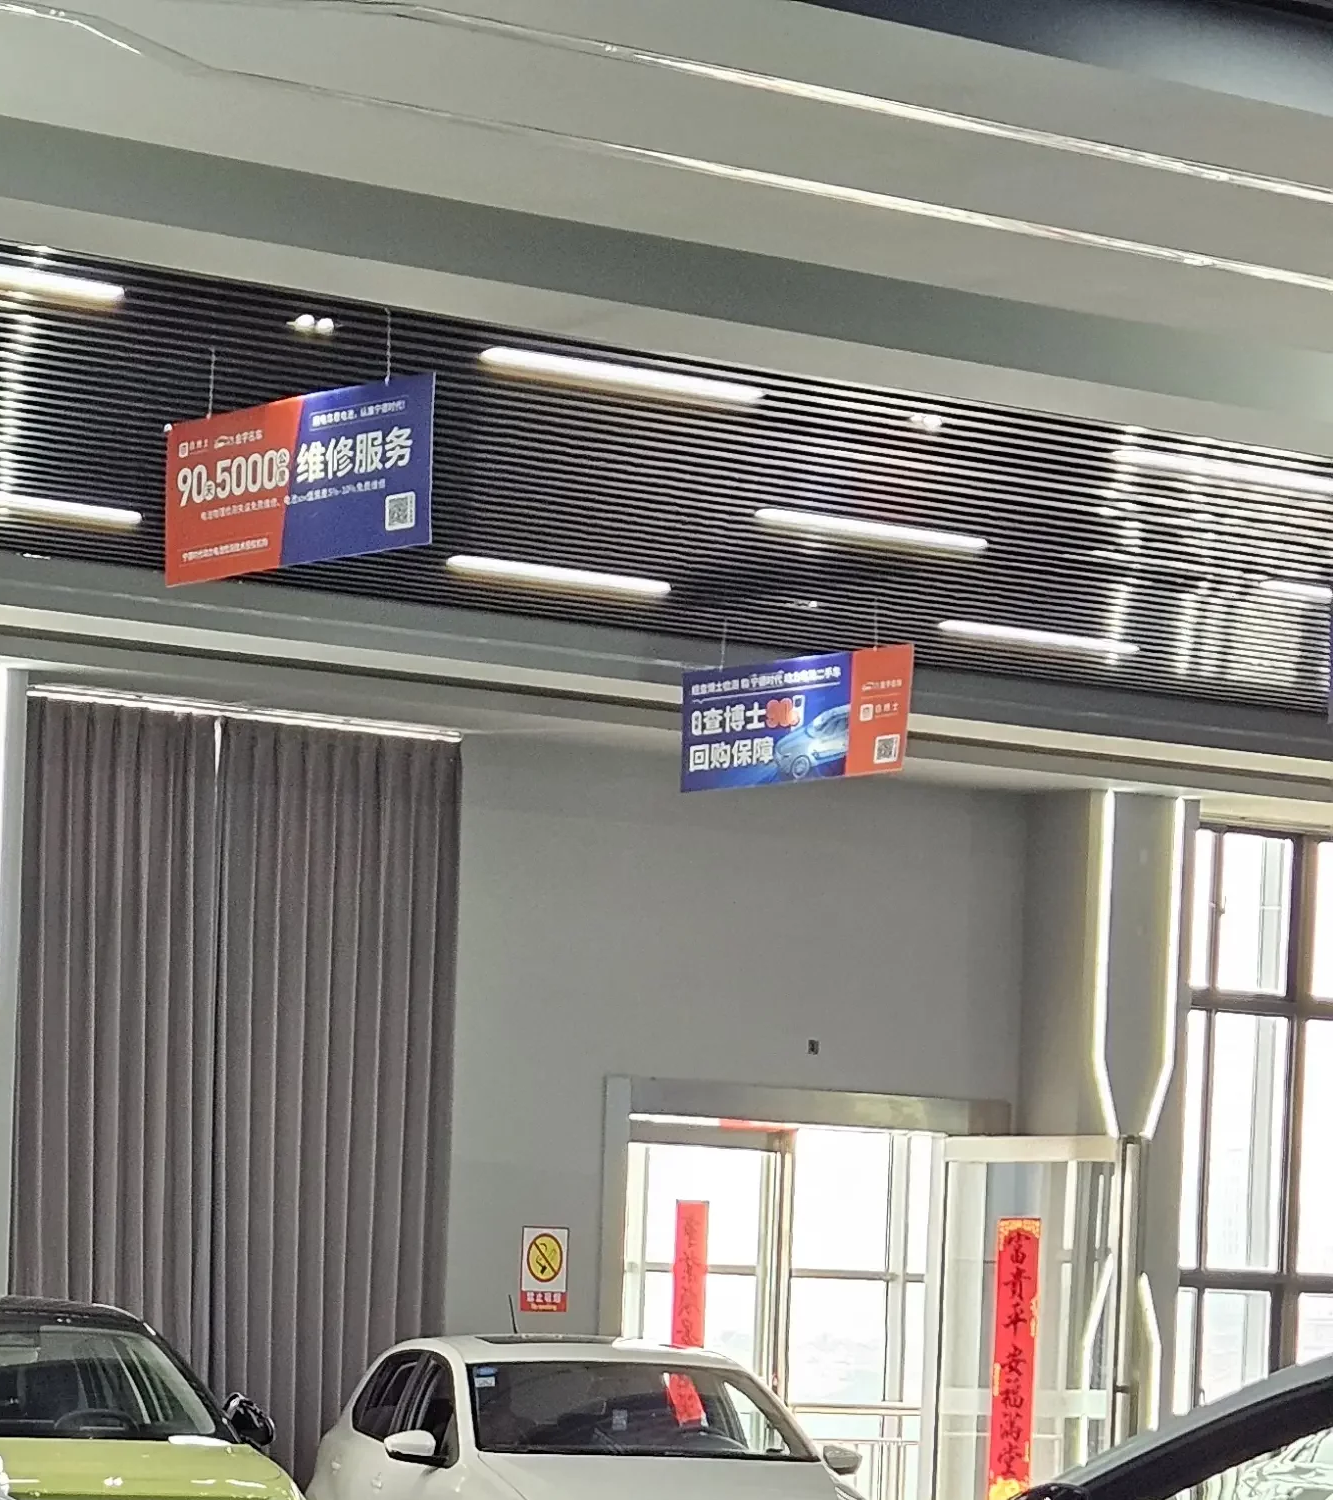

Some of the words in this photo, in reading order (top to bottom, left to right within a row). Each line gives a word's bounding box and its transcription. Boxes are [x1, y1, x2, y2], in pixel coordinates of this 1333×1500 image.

[296, 426, 413, 484] 维修服务
[703, 702, 766, 735] 查博士
[689, 736, 774, 772] 回购保障
